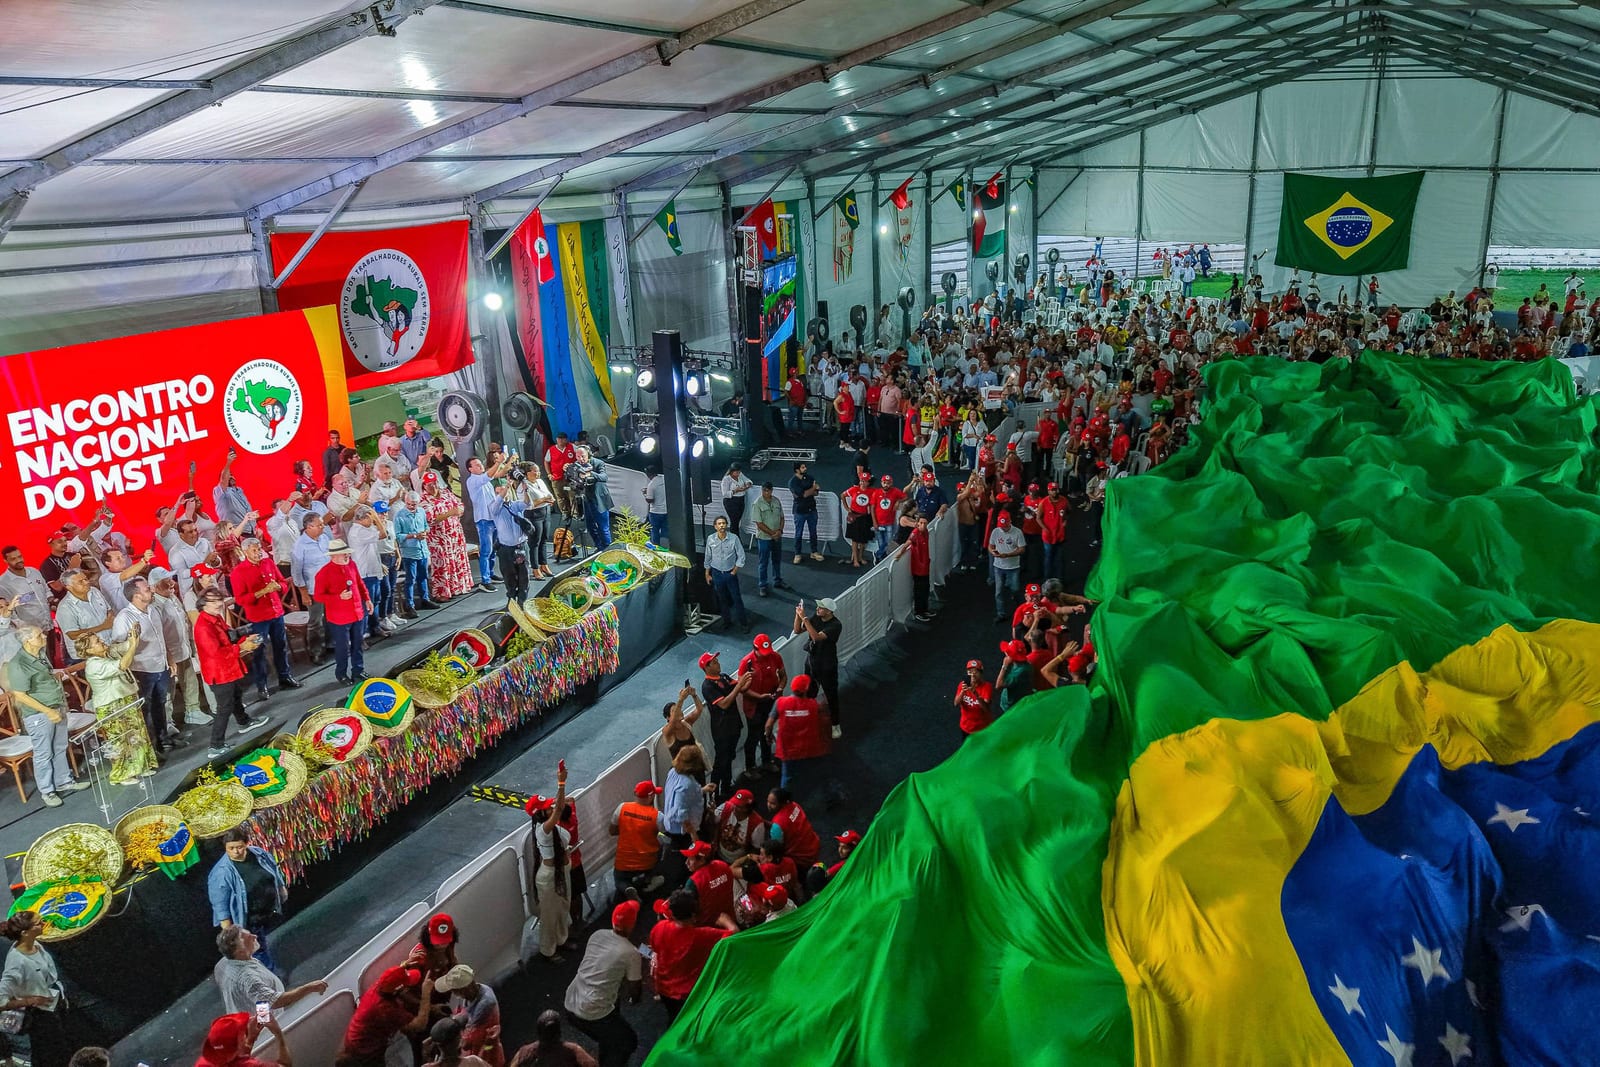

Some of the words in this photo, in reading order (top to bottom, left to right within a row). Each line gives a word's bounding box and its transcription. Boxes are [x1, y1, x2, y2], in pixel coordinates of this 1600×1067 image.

[355, 253, 407, 274] TRABALHADORES
[408, 263, 423, 289] RURAIS
[346, 275, 356, 293] DOS
[343, 296, 358, 349] MOVIMENTO
[419, 312, 427, 337] TERRA
[379, 359, 399, 368] BRASIL
[7, 374, 215, 447] ENCONTRO
[227, 398, 240, 438] MOVIMENTO
[235, 362, 279, 381] TRABALHADORES
[280, 369, 295, 387] RURAIS
[15, 411, 208, 484] NACIONAL
[261, 442, 279, 450] BRASIL
[23, 477, 85, 520] DO
[90, 453, 166, 502] MST
